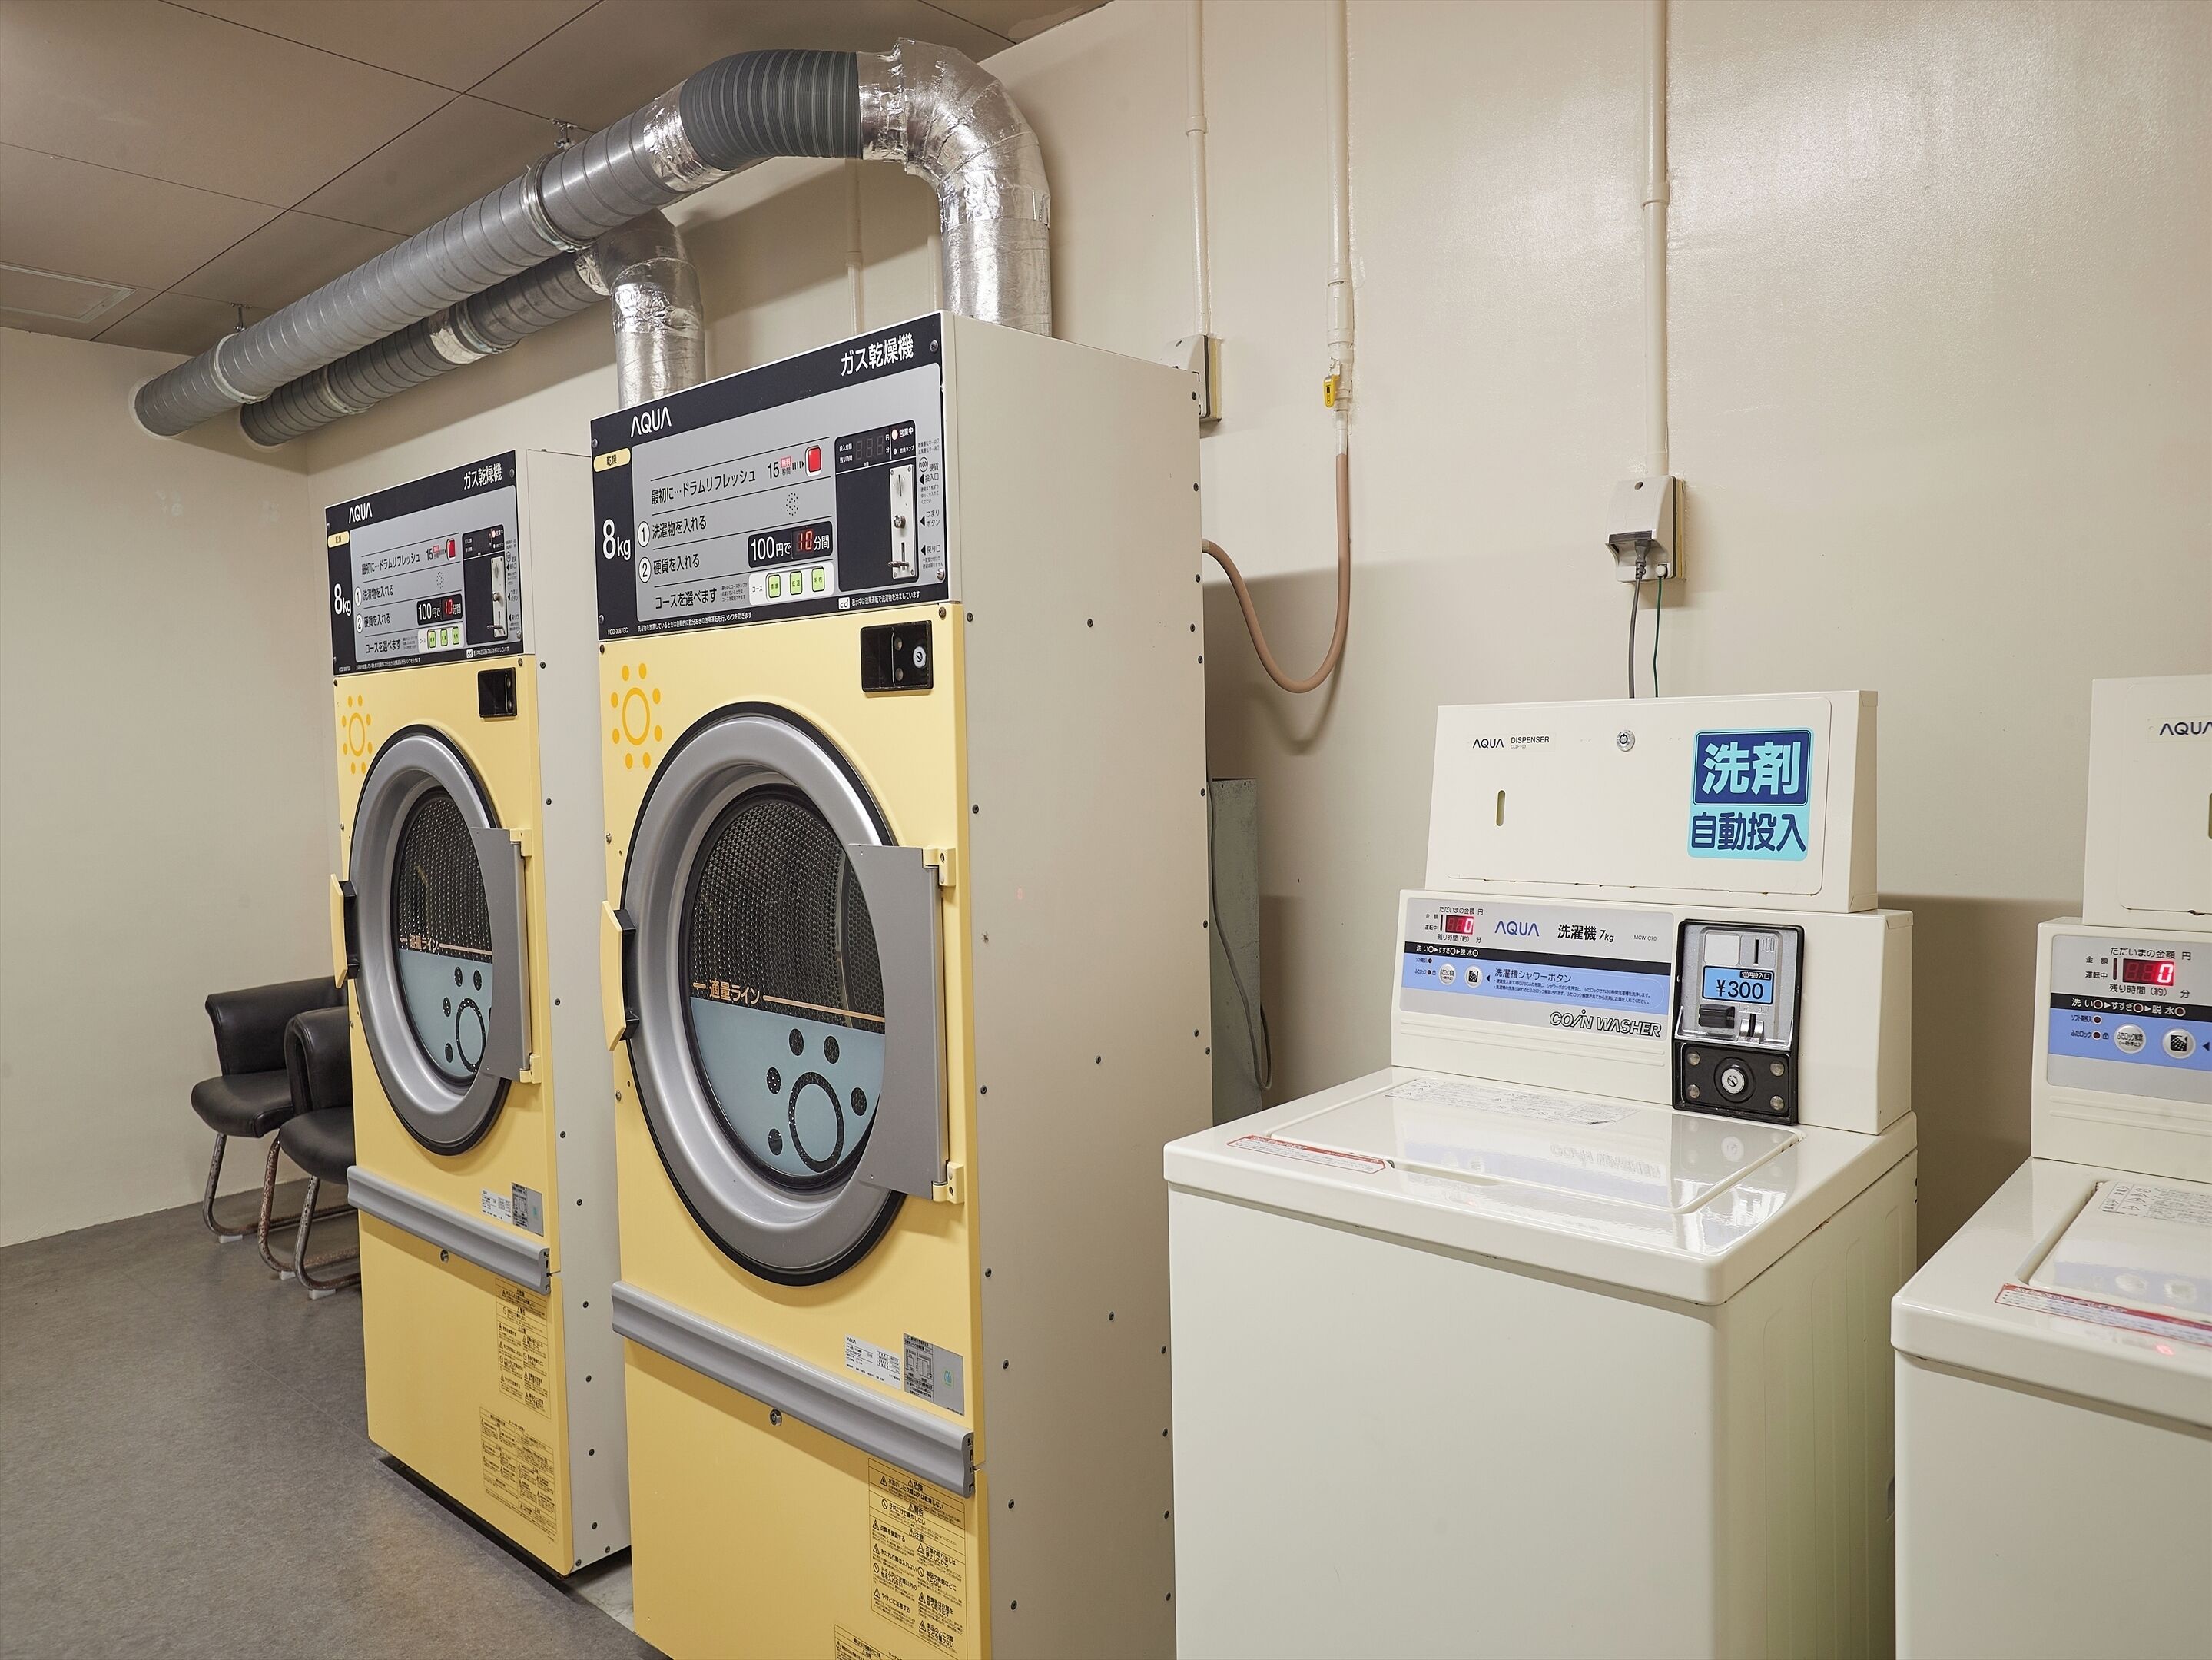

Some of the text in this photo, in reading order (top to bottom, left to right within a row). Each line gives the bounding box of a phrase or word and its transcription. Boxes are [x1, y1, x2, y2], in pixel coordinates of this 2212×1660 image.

[841, 333, 914, 377] ガス乾燥機
[630, 407, 672, 438] AQUA
[463, 463, 502, 490] ガス乾燥機
[768, 461, 779, 479] 15
[348, 502, 373, 524] AQUA
[926, 509, 940, 517] つまり
[652, 516, 707, 540] 洗濯物を入れる
[602, 519, 632, 561] 8kg
[426, 549, 433, 561] 15
[653, 556, 700, 575] 硬貨を入れる
[334, 583, 351, 616] 8kg
[655, 587, 718, 610] コースを選べます
[365, 639, 401, 654] コースを選べます
[2159, 721, 2212, 736] AQUA
[1472, 735, 1550, 749] AQUA DISPENSER
[1700, 741, 1802, 795] 洗剤
[1692, 812, 1806, 853] 自動投入
[1439, 906, 1474, 915] ただいまの金額
[1494, 921, 1540, 937] AQUA
[1557, 924, 1614, 942] 洗濯機 7kg
[2110, 947, 2191, 961] ただいまの金額 円
[1494, 968, 1572, 983] 洗濯槽シャワーボタン
[2084, 971, 2108, 980] 運転中
[708, 979, 762, 1004] 適量ライン
[1716, 979, 1764, 1000] ¥300
[2180, 989, 2190, 998] 分
[2111, 1002, 2133, 1011] すすぎ
[1597, 1017, 1662, 1038] WASHER
